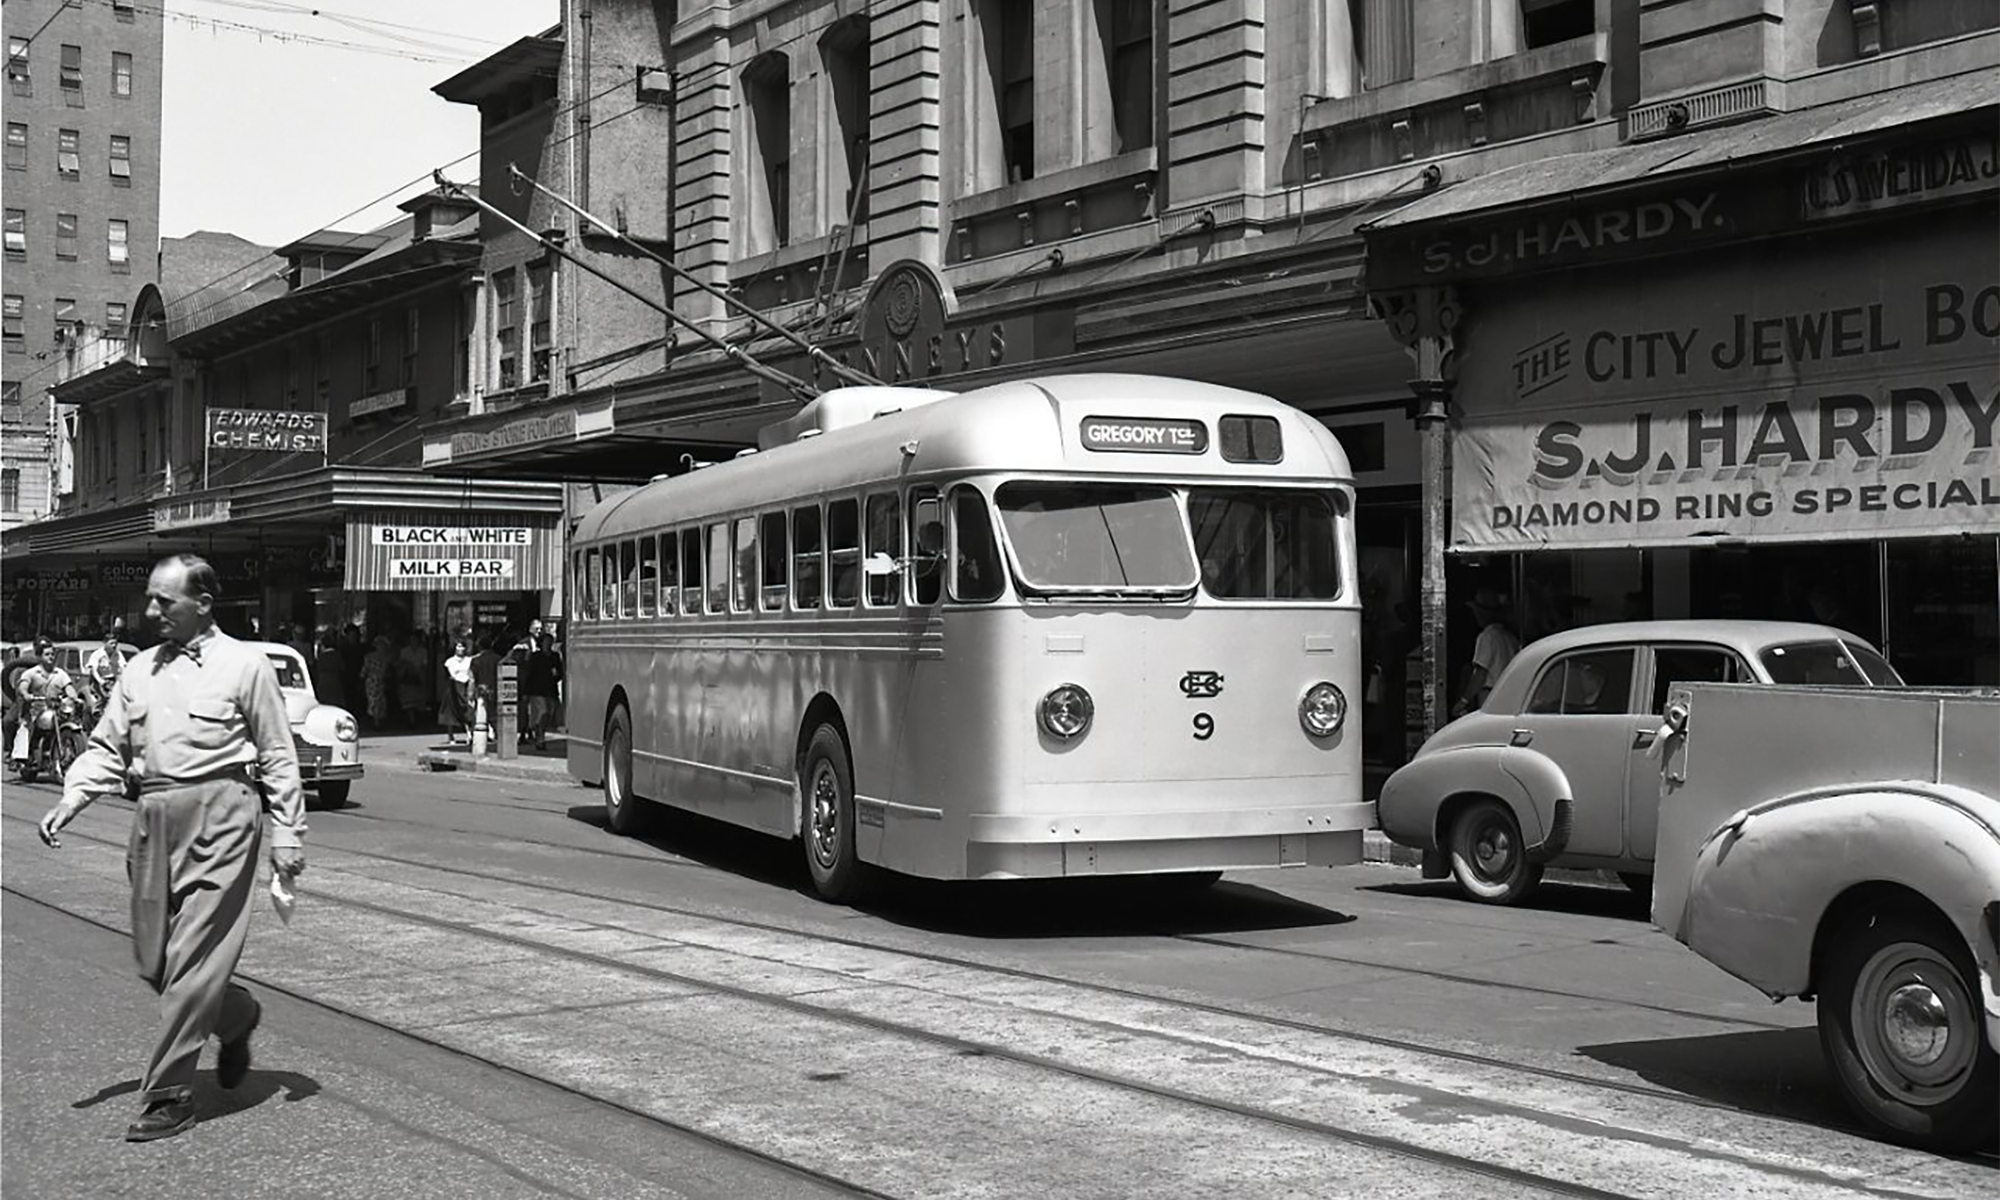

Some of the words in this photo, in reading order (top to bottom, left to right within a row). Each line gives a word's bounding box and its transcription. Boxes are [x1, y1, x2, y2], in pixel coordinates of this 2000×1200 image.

[1512, 339, 1571, 390] THE
[1584, 328, 1700, 383] CITY
[1710, 302, 1901, 370] JEWEL
[216, 410, 320, 429] EDWARDS
[213, 431, 325, 450] CHEMIST
[1087, 424, 1167, 444] GREGORY
[1493, 497, 1661, 530] DIAMOND
[1675, 490, 1774, 520] RING
[1791, 478, 2000, 516] SPECIAL
[382, 529, 447, 544] BLACK
[469, 529, 527, 544] WHITE
[399, 561, 451, 575] MILK
[459, 561, 503, 575] BAR
[1192, 712, 1215, 741] 9
